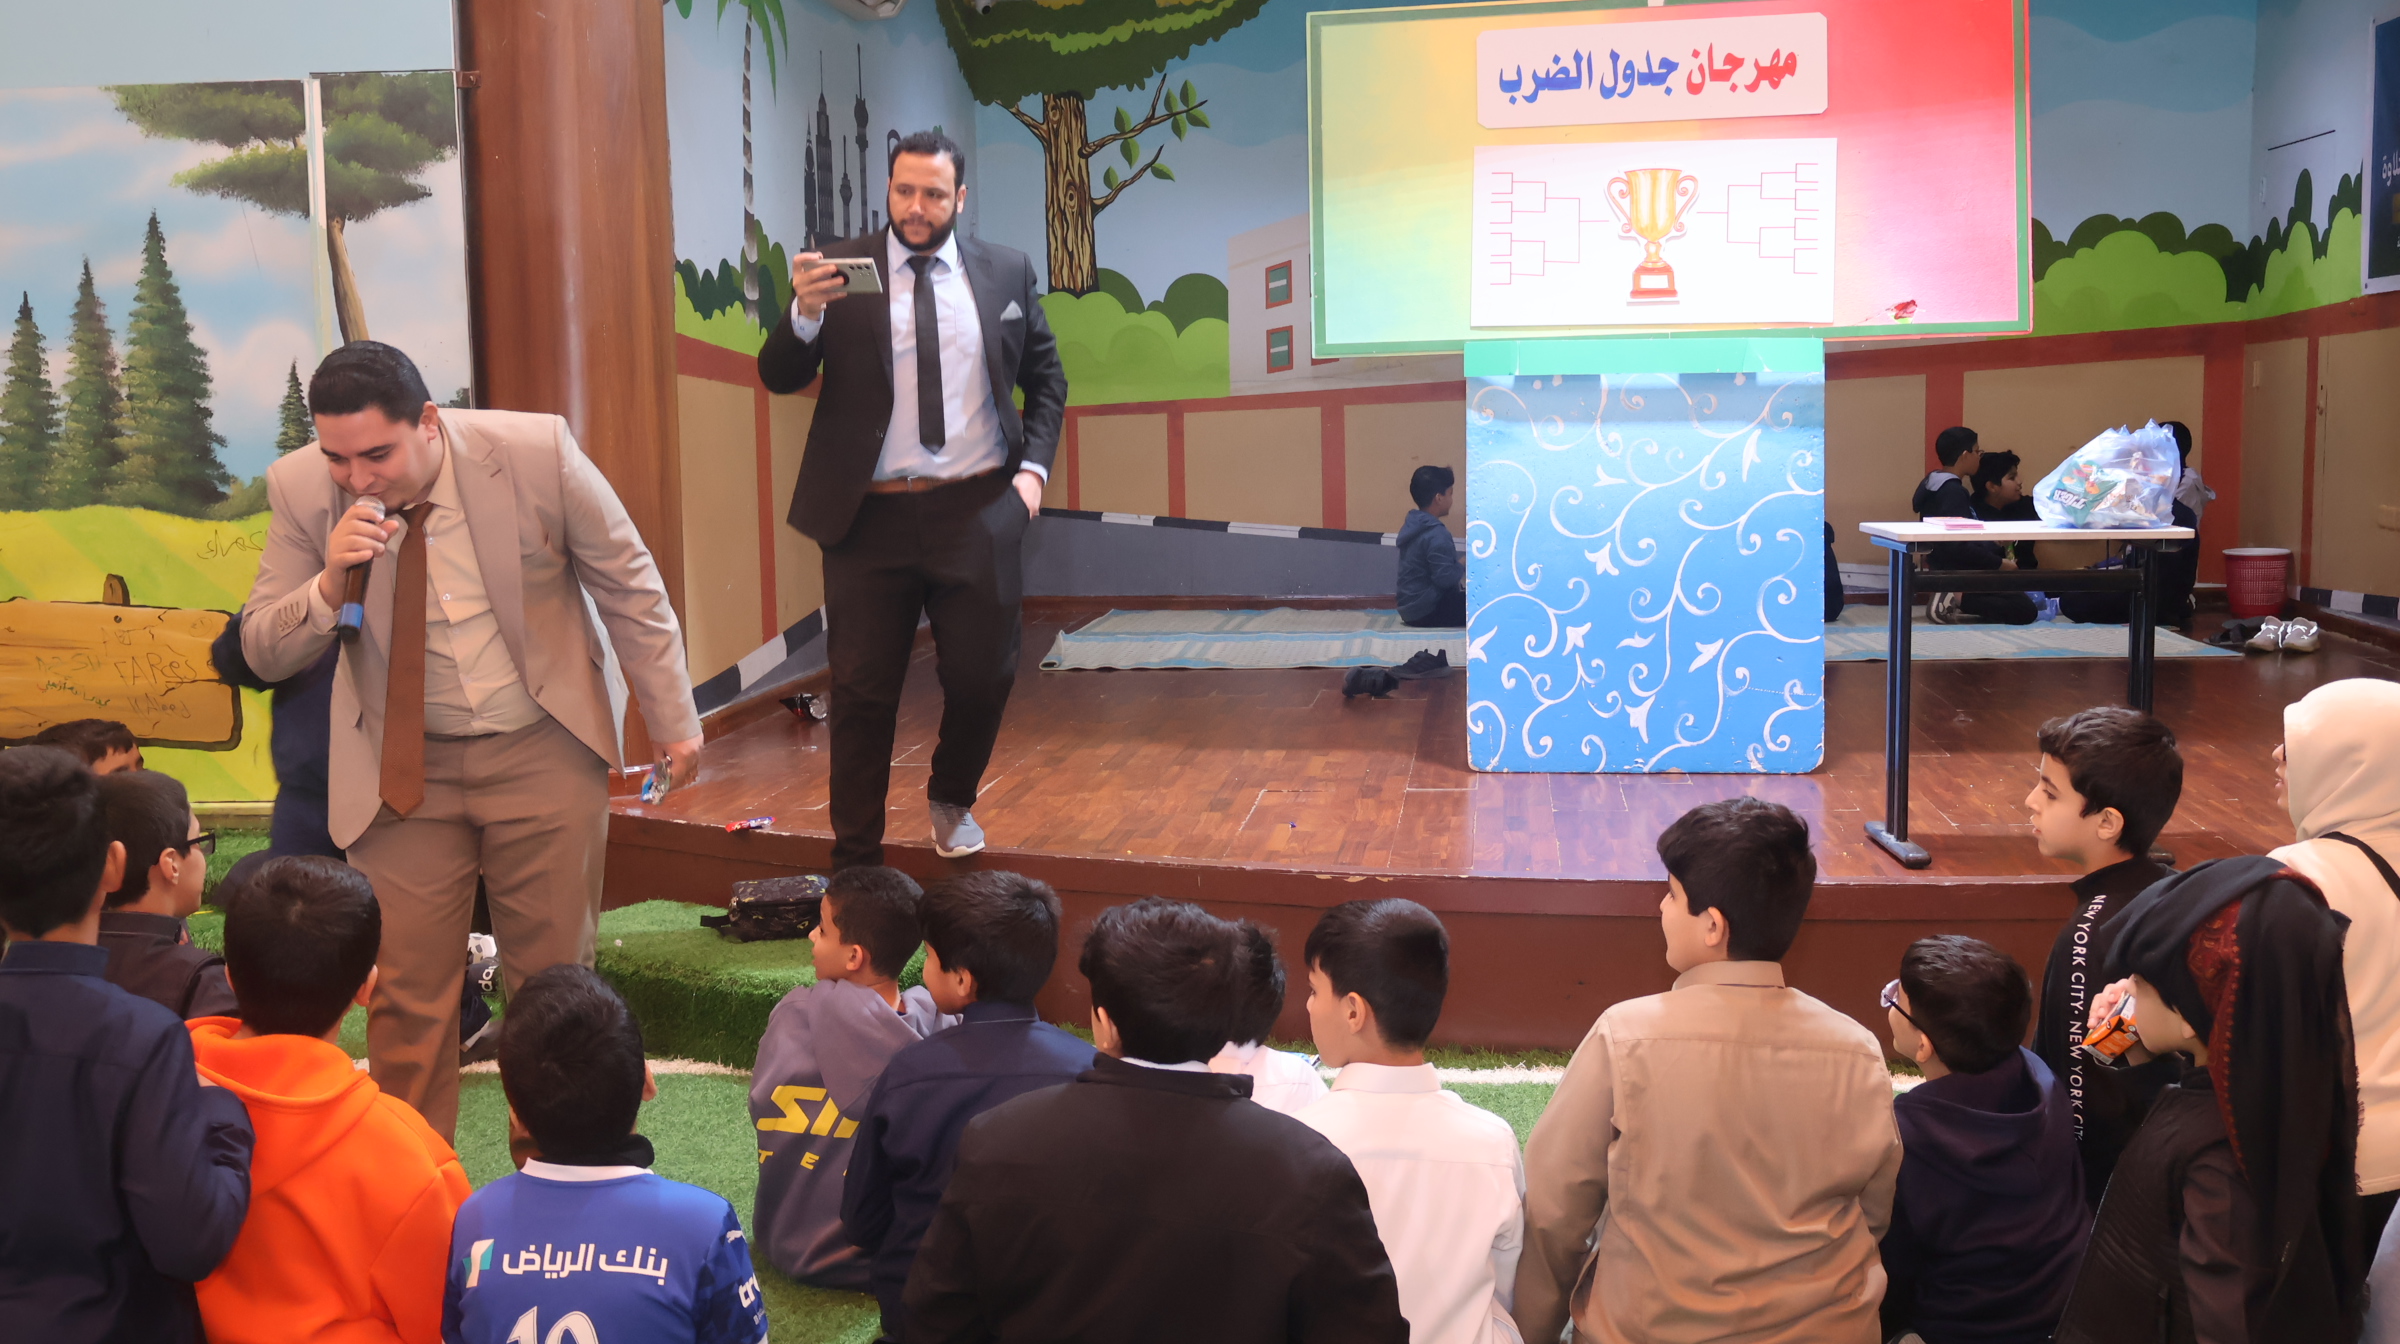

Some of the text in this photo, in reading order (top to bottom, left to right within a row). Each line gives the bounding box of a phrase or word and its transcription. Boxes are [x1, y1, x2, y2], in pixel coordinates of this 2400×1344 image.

[1499, 42, 1797, 105] مهرجان جدول الضرب
[2053, 489, 2088, 510] TIGER
[2083, 894, 2107, 920] NEW
[2072, 922, 2091, 966] YORK
[2069, 1021, 2083, 1060] NEW
[2069, 1065, 2083, 1109] YORK
[502, 1243, 668, 1285] بنك الرياض
